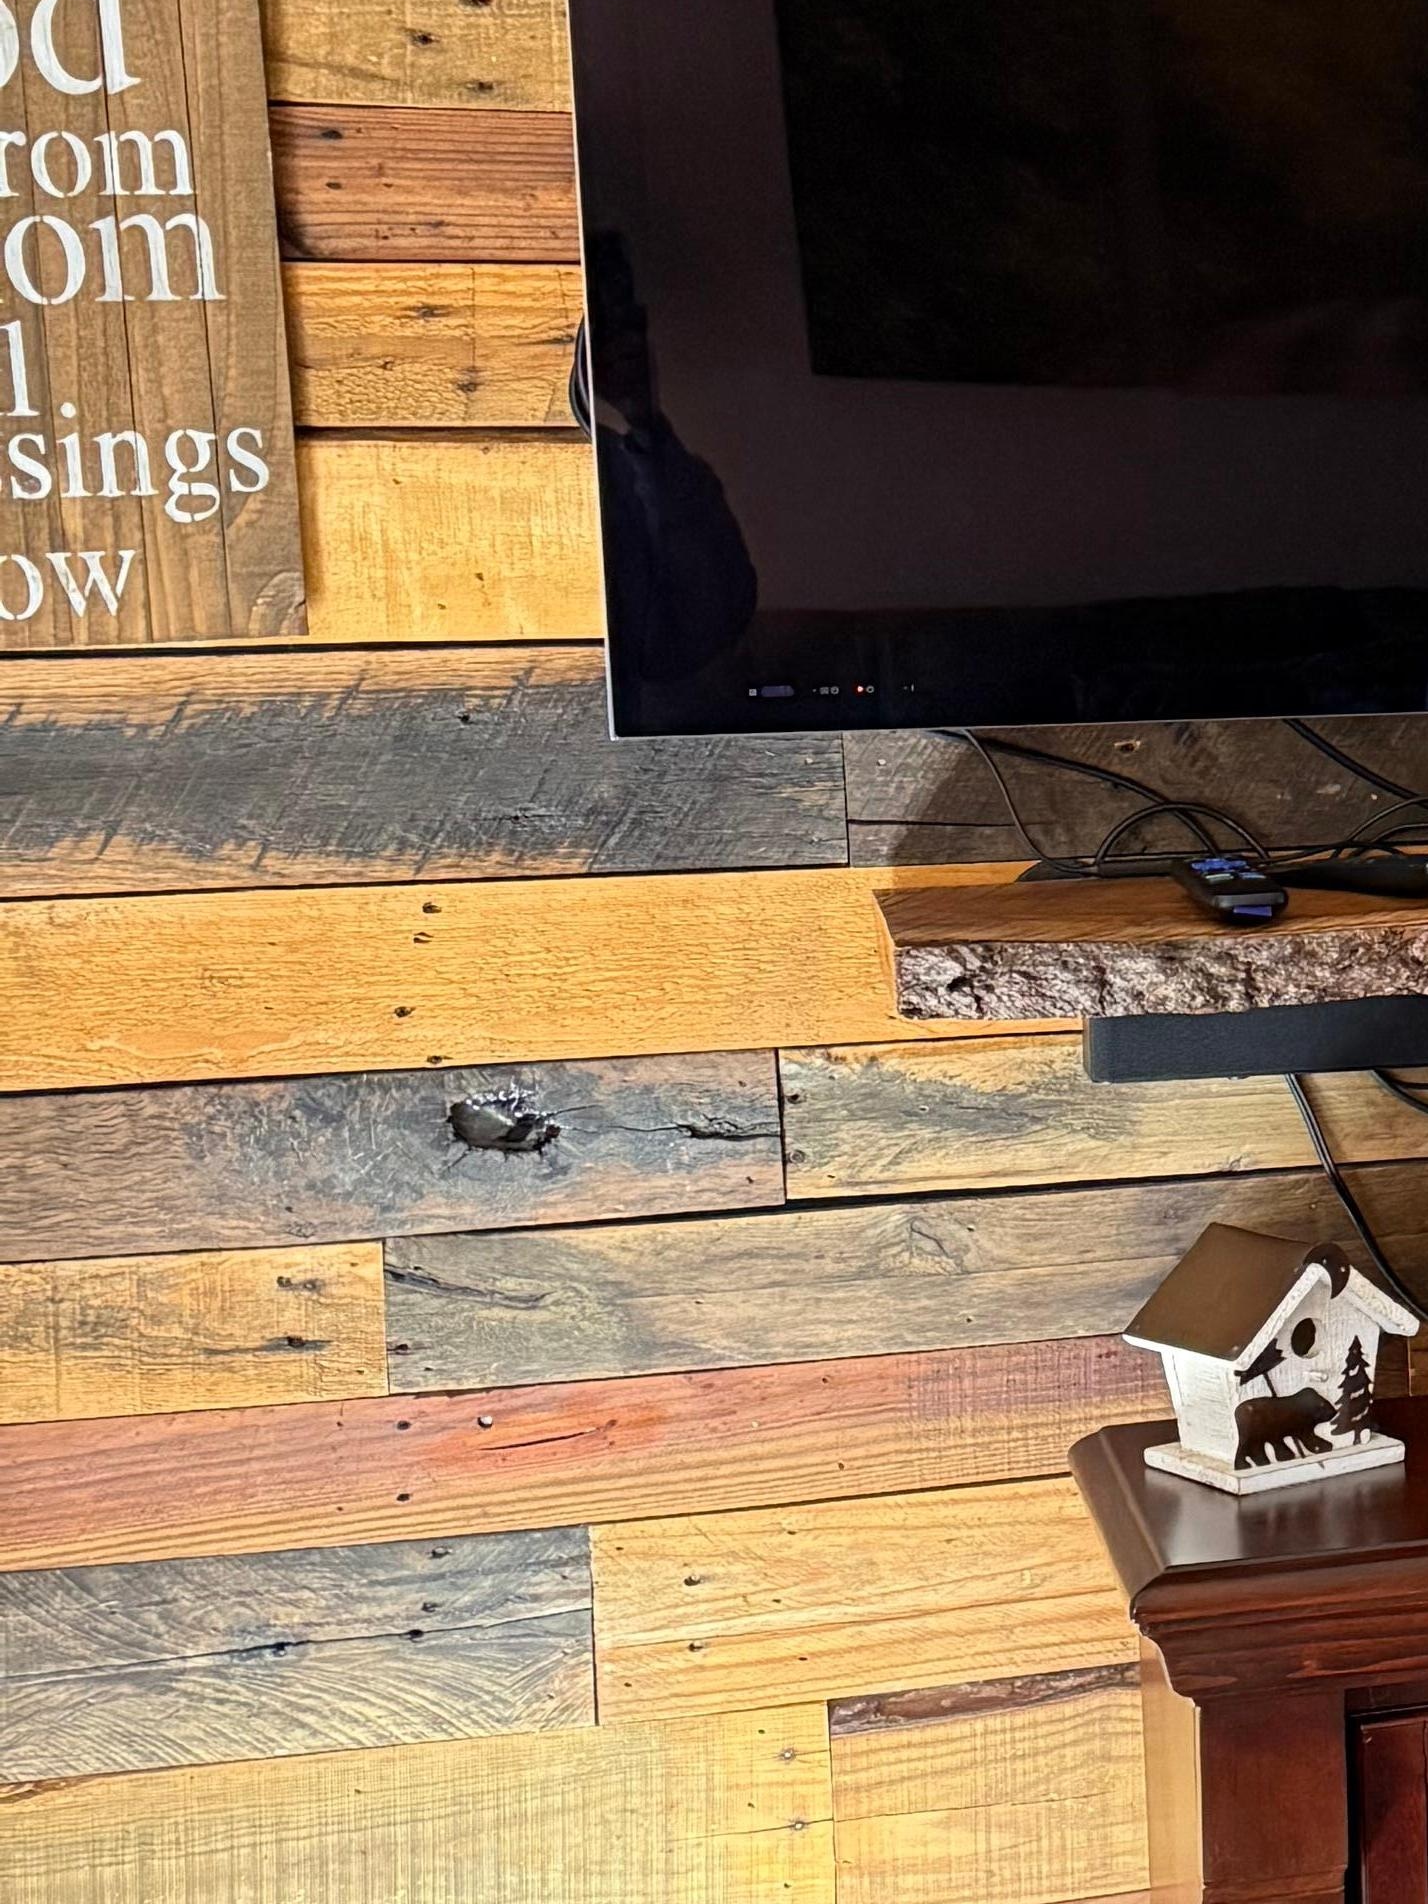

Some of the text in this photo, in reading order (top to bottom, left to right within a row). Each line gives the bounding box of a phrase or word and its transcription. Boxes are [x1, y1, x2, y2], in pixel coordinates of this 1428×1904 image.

[0, 129, 198, 199] rom
[2, 212, 228, 306] om
[0, 401, 271, 524] sings
[0, 549, 137, 621] ow
